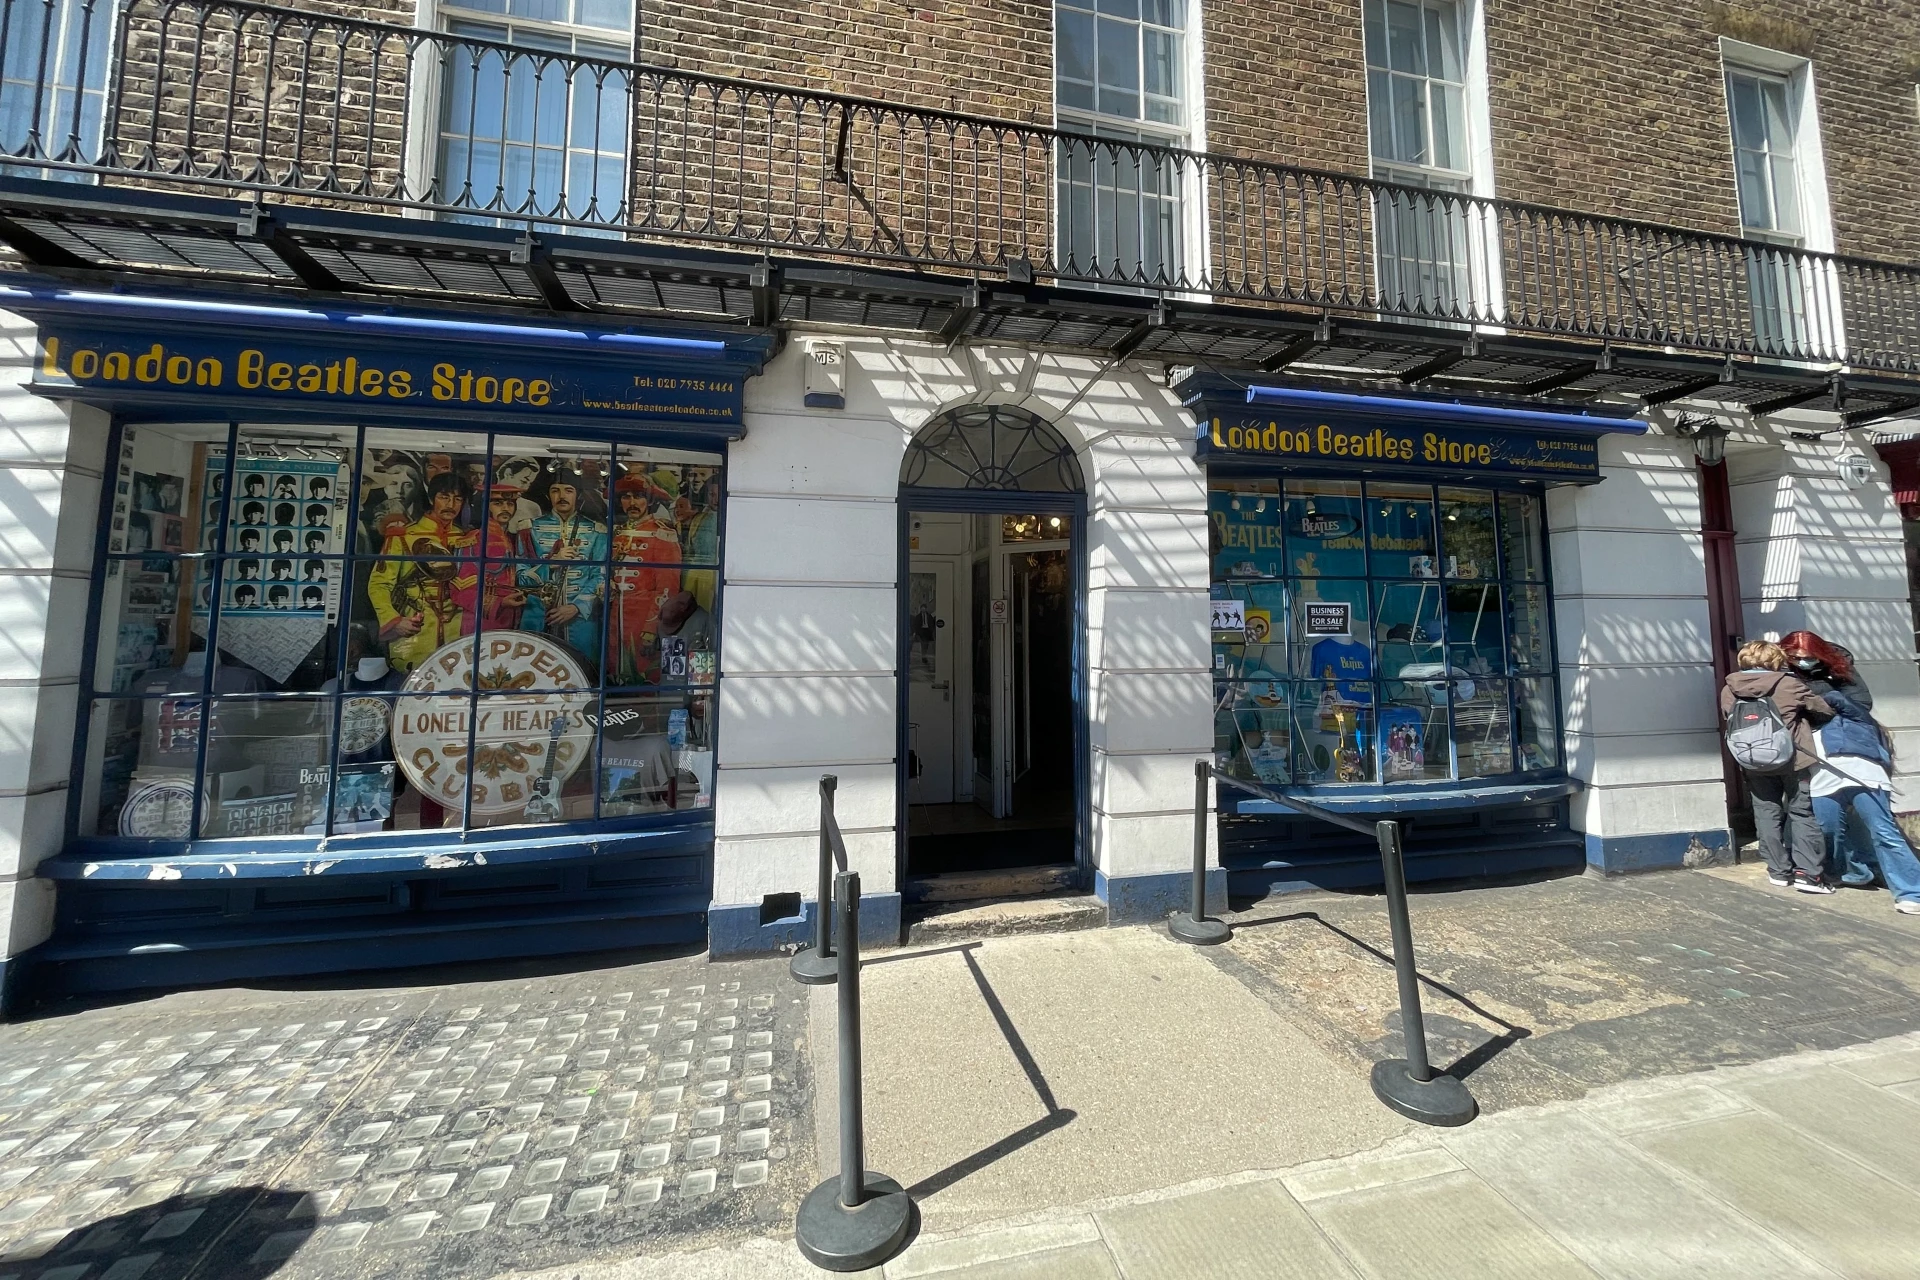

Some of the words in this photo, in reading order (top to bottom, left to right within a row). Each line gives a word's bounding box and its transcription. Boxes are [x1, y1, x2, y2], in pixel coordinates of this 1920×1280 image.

[815, 351, 836, 366] MJS
[42, 337, 223, 387] London
[237, 349, 412, 398] Beatles
[431, 362, 551, 407] Store
[633, 376, 654, 388] Tel:
[657, 378, 677, 389] 020
[679, 379, 706, 391] 7935
[1212, 417, 1310, 453] London
[1317, 424, 1414, 460] Beatles
[1423, 432, 1491, 465] Store
[1240, 511, 1256, 521] THE
[1302, 517, 1340, 533] BEATLES
[1310, 607, 1344, 615] BUSINESS
[401, 710, 492, 735] LONELY
[503, 706, 584, 731] HEARTS
[586, 709, 639, 727] BEATLES
[607, 758, 645, 767] BEATLES
[412, 747, 487, 804] CLUB
